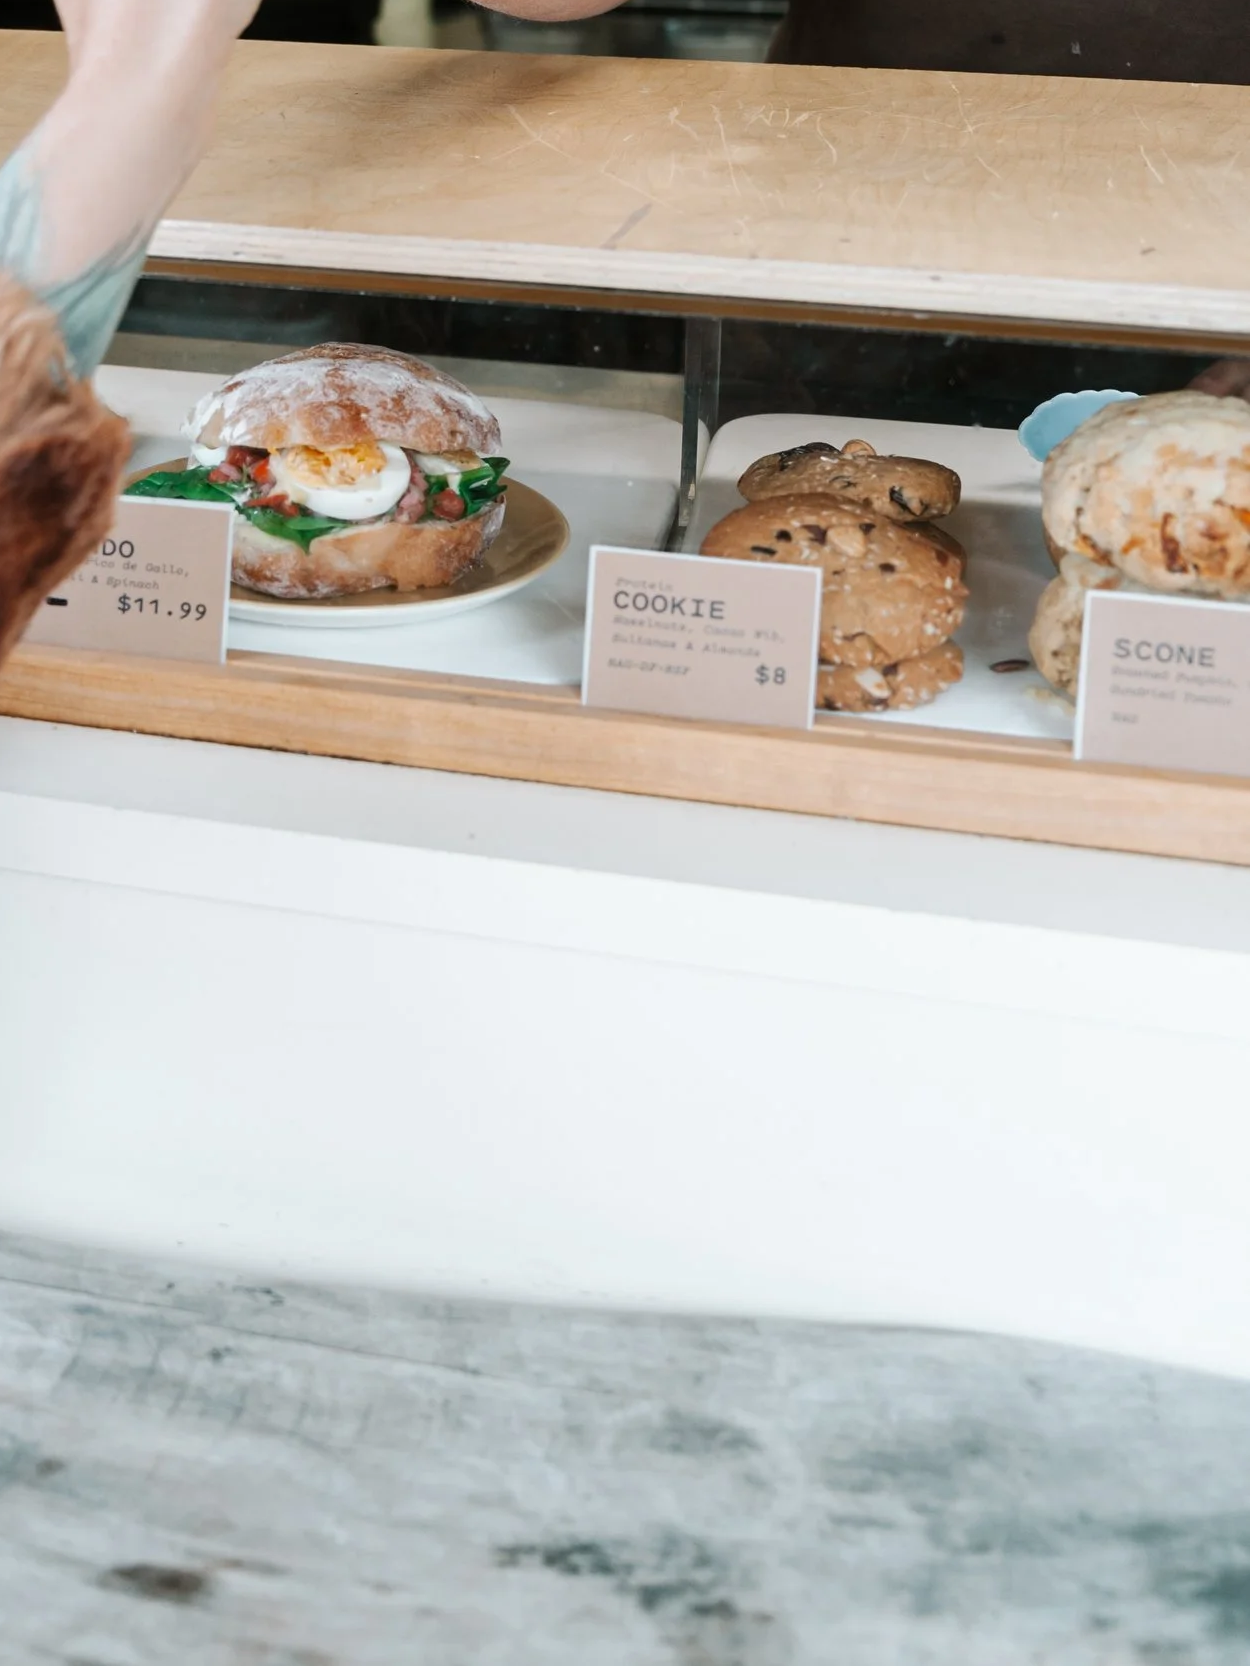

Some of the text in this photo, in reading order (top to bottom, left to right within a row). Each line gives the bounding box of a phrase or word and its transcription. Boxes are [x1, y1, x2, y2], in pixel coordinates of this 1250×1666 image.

[101, 539, 135, 559] DO
[122, 561, 138, 572] de
[145, 562, 190, 578] Gallo,
[106, 576, 160, 590] Spinach
[614, 577, 674, 592] Protein
[117, 593, 207, 621] $11.99
[614, 591, 725, 620] COOKIE
[1113, 638, 1215, 667] SCONE
[754, 662, 788, 686] $8
